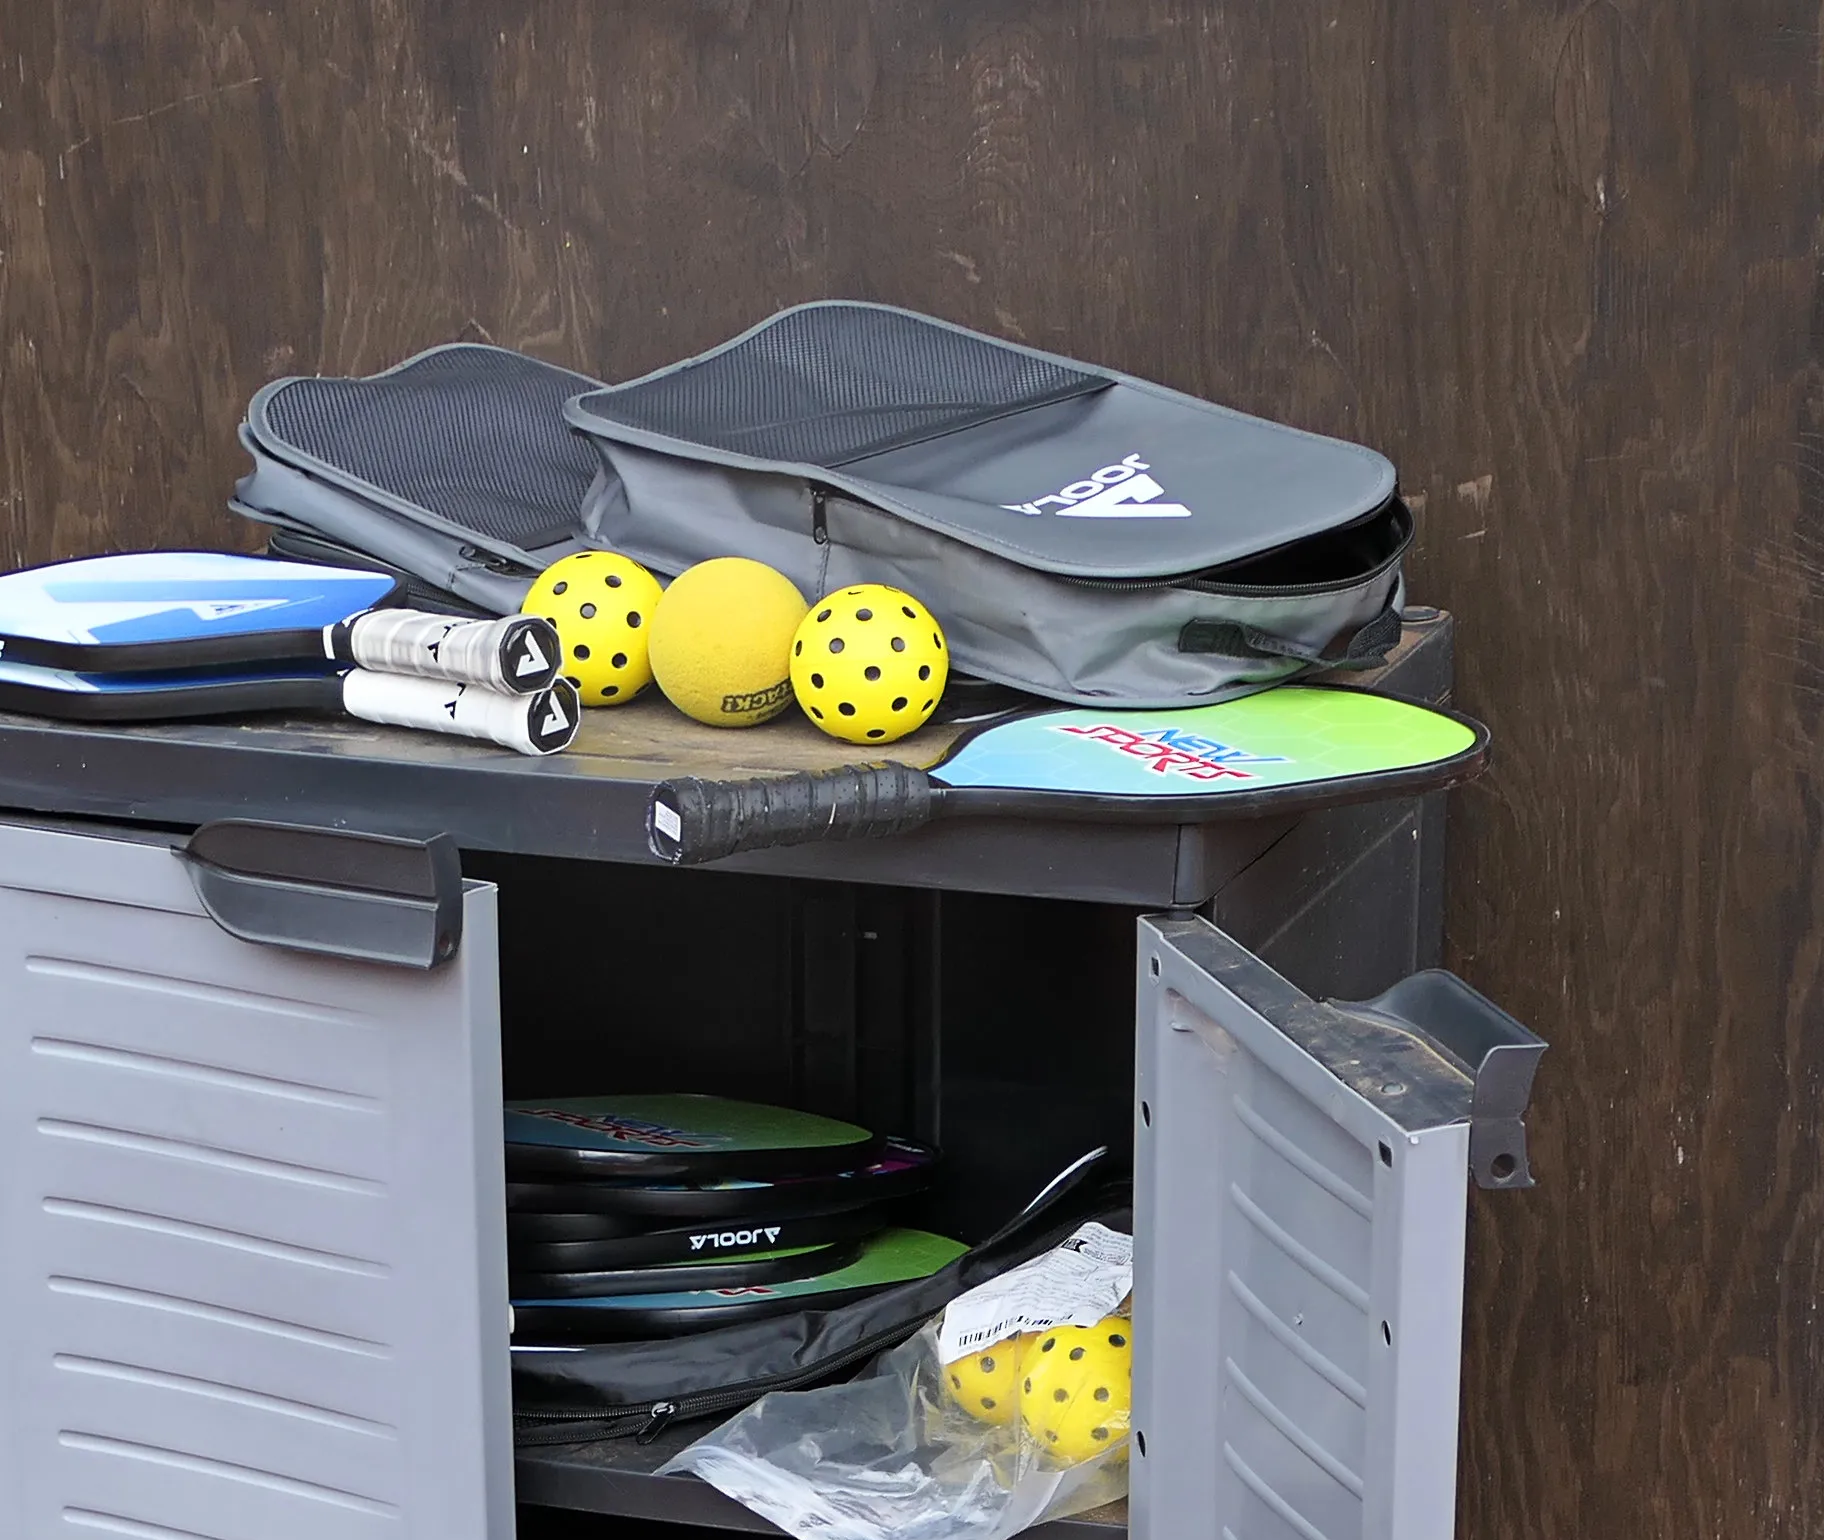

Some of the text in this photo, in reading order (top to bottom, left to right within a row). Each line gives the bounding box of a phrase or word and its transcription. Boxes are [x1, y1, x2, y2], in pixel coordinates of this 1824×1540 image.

[1000, 453, 1150, 517] JOOLA
[1058, 725, 1255, 780] SPORTS
[1138, 728, 1288, 763] NEW
[688, 1229, 764, 1251] JOOLA
